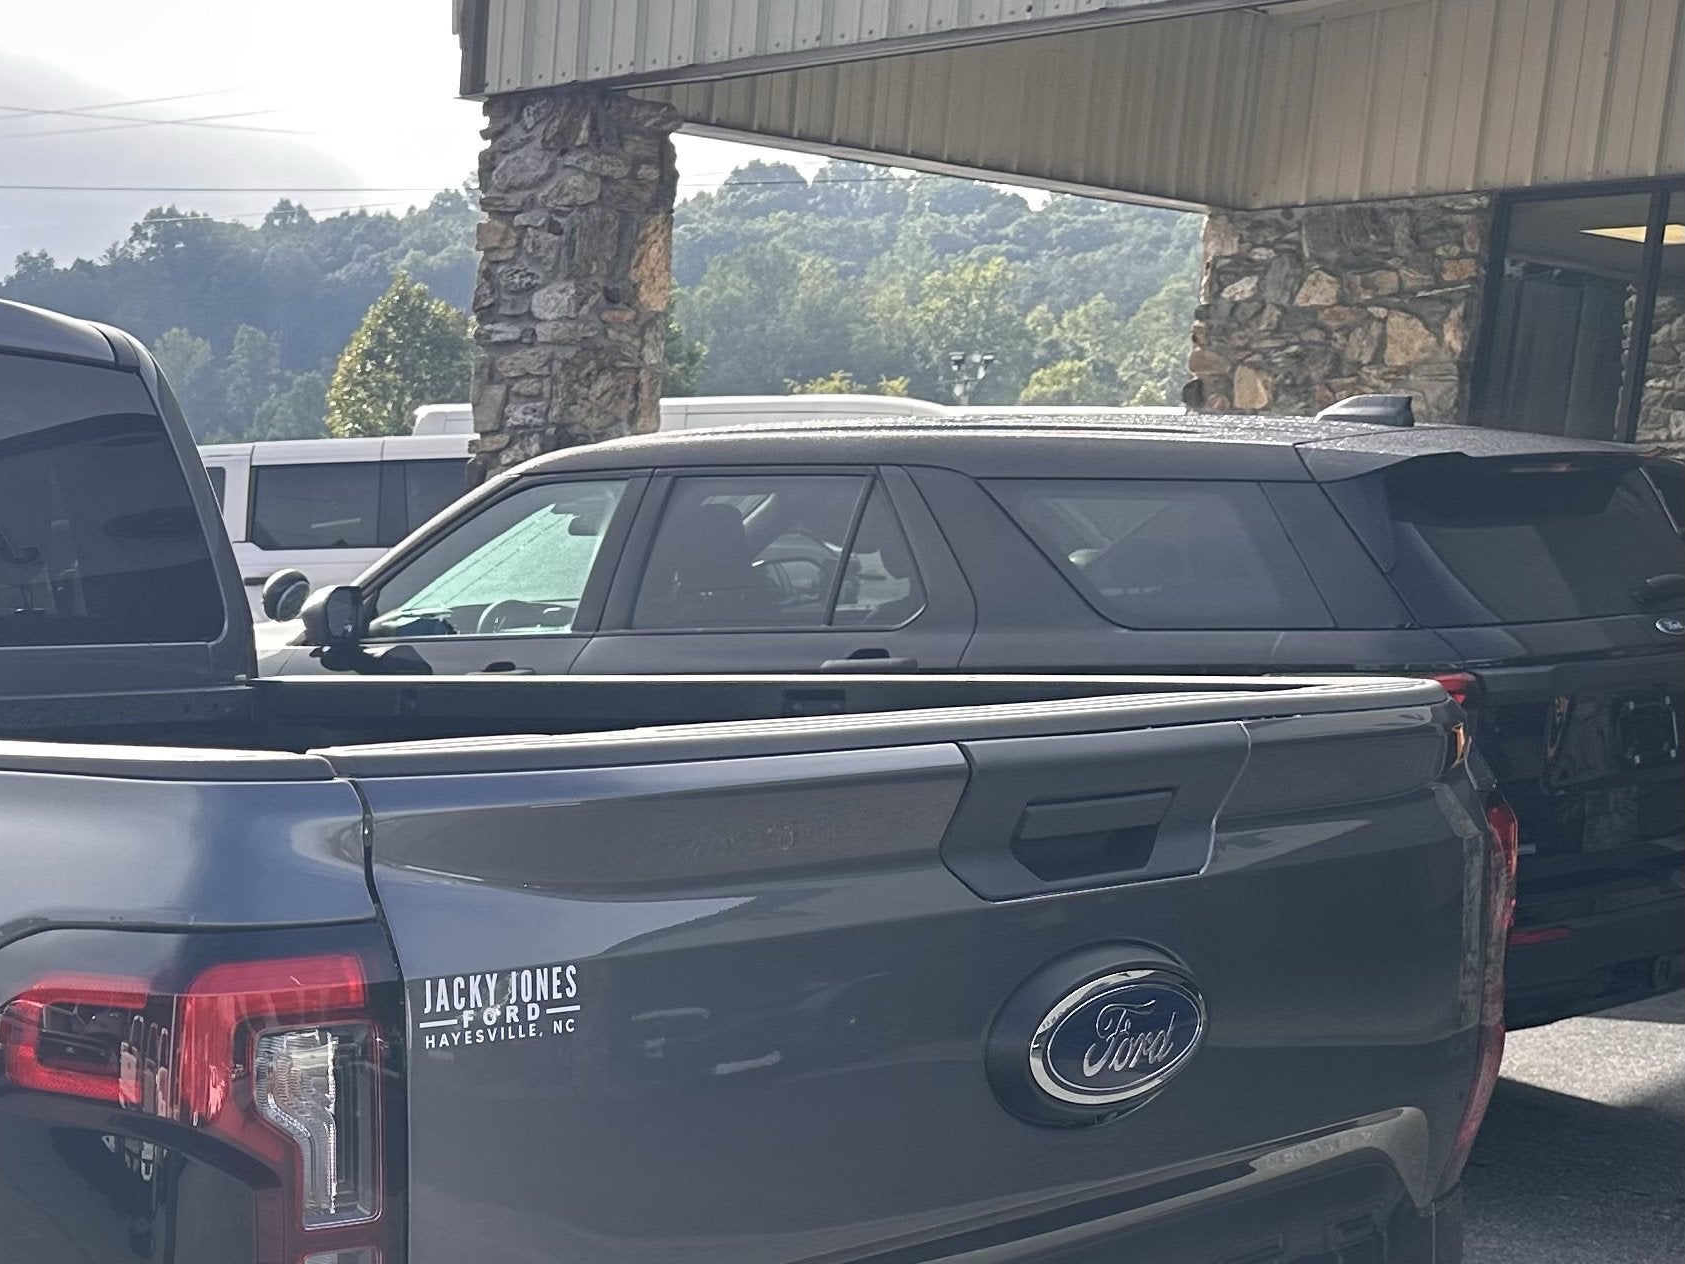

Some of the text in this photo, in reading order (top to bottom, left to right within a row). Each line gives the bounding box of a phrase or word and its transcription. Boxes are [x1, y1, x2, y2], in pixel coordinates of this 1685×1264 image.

[423, 965, 577, 1014] JACKY JONES
[425, 1018, 575, 1049] HAYESVILLE, NC
[463, 1003, 541, 1029] FORD
[1082, 999, 1177, 1077] Ford
